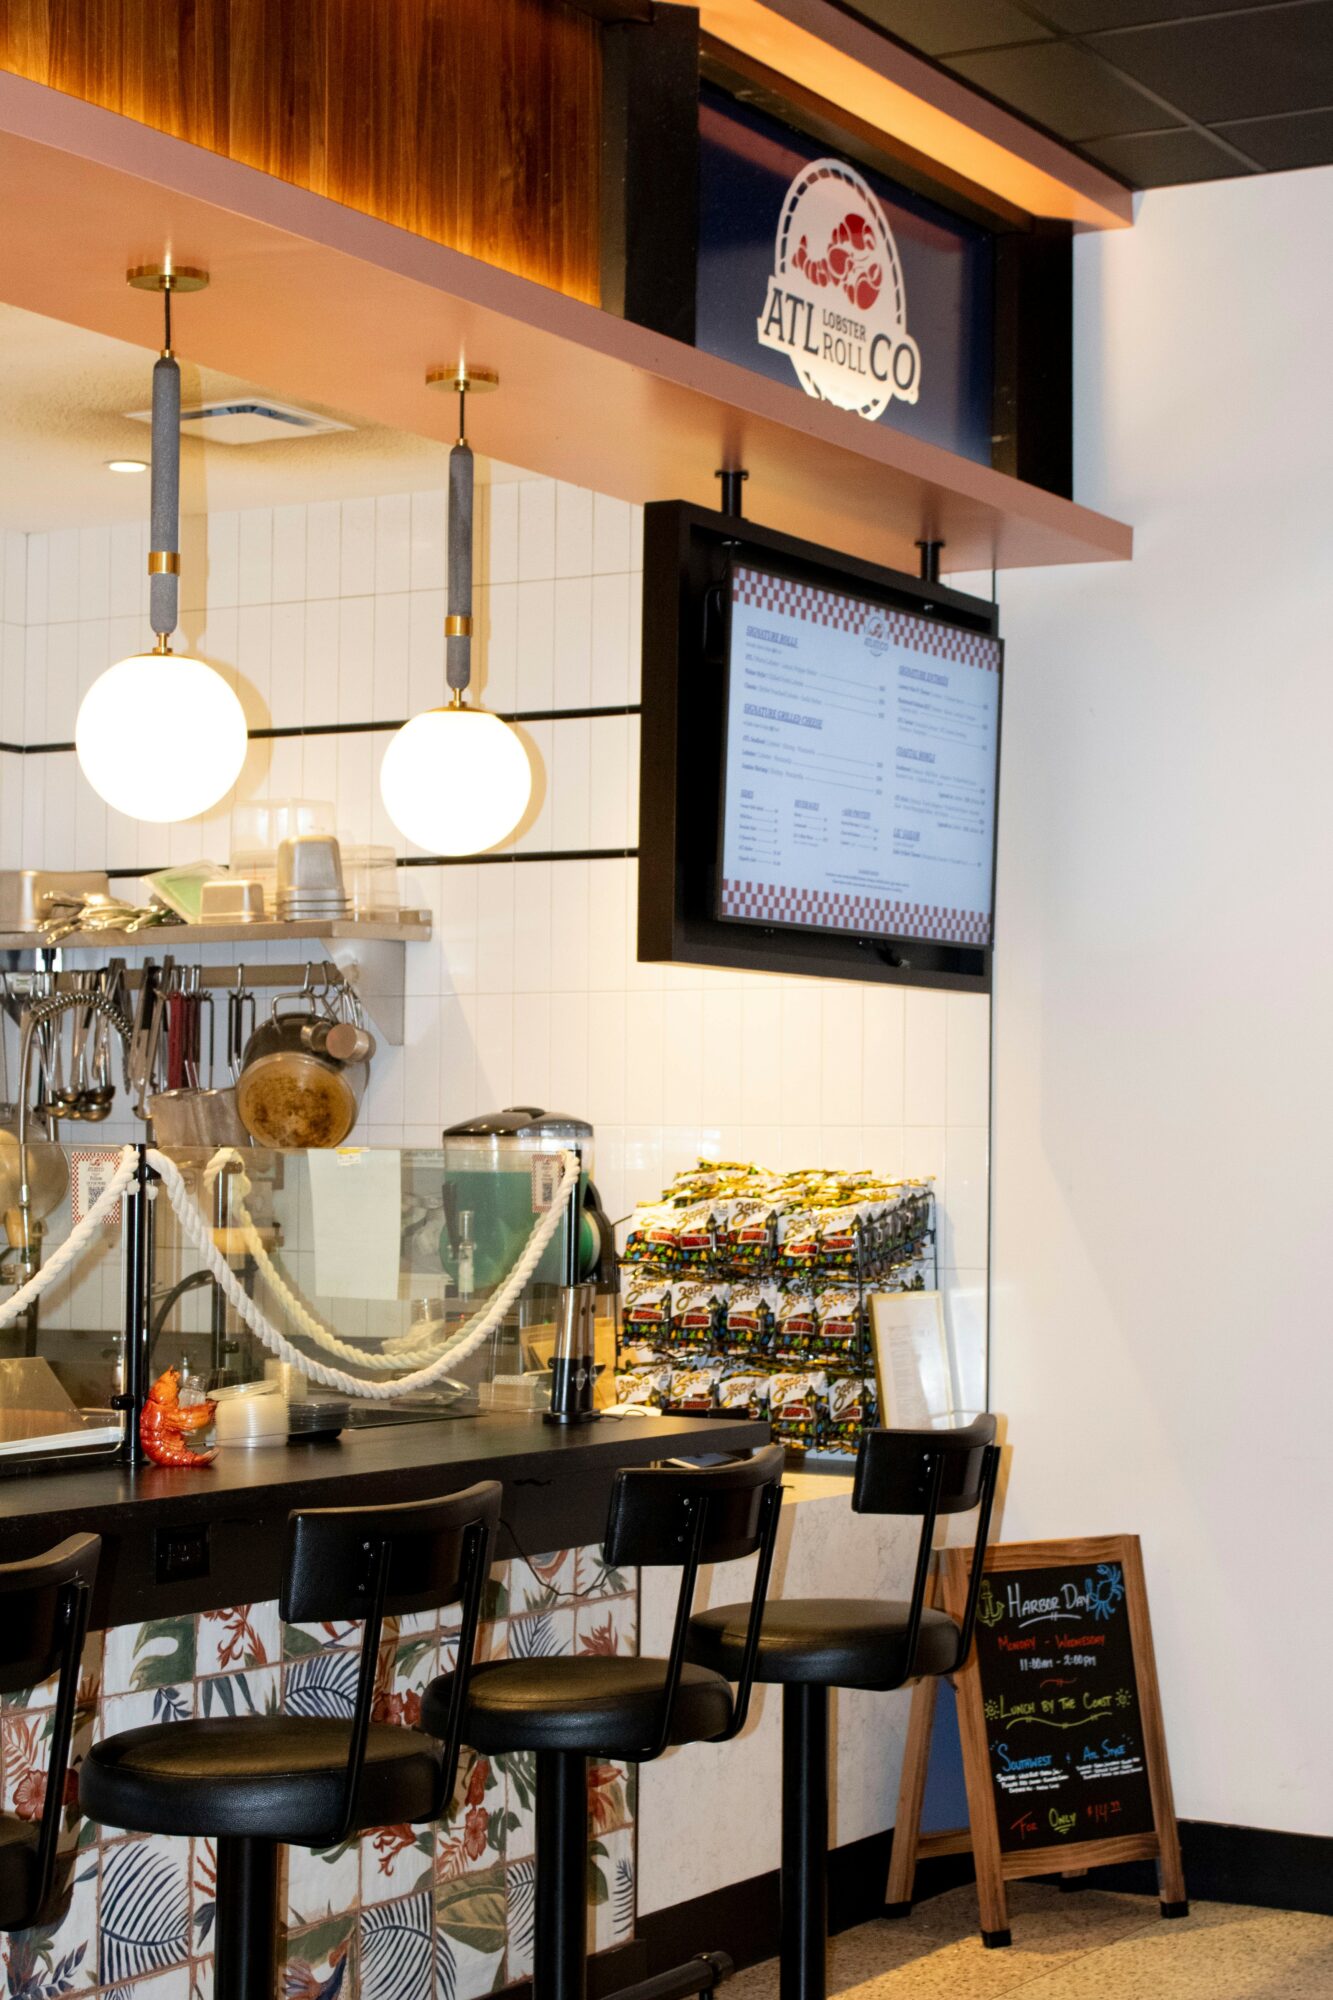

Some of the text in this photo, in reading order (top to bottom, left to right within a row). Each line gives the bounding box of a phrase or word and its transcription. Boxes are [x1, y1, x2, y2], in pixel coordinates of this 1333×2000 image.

[764, 287, 819, 356] ATL
[822, 308, 867, 342] LOBSTER
[823, 331, 867, 376] ROLL
[869, 332, 916, 391] CO
[1007, 1582, 1090, 1618] HARBOR DAY
[998, 1635, 1036, 1652] MONDAY
[1055, 1633, 1105, 1650] WEDNESDAY
[1000, 1692, 1112, 1718] LUNCH BY THE COAST
[1048, 1808, 1077, 1828] ONLY
